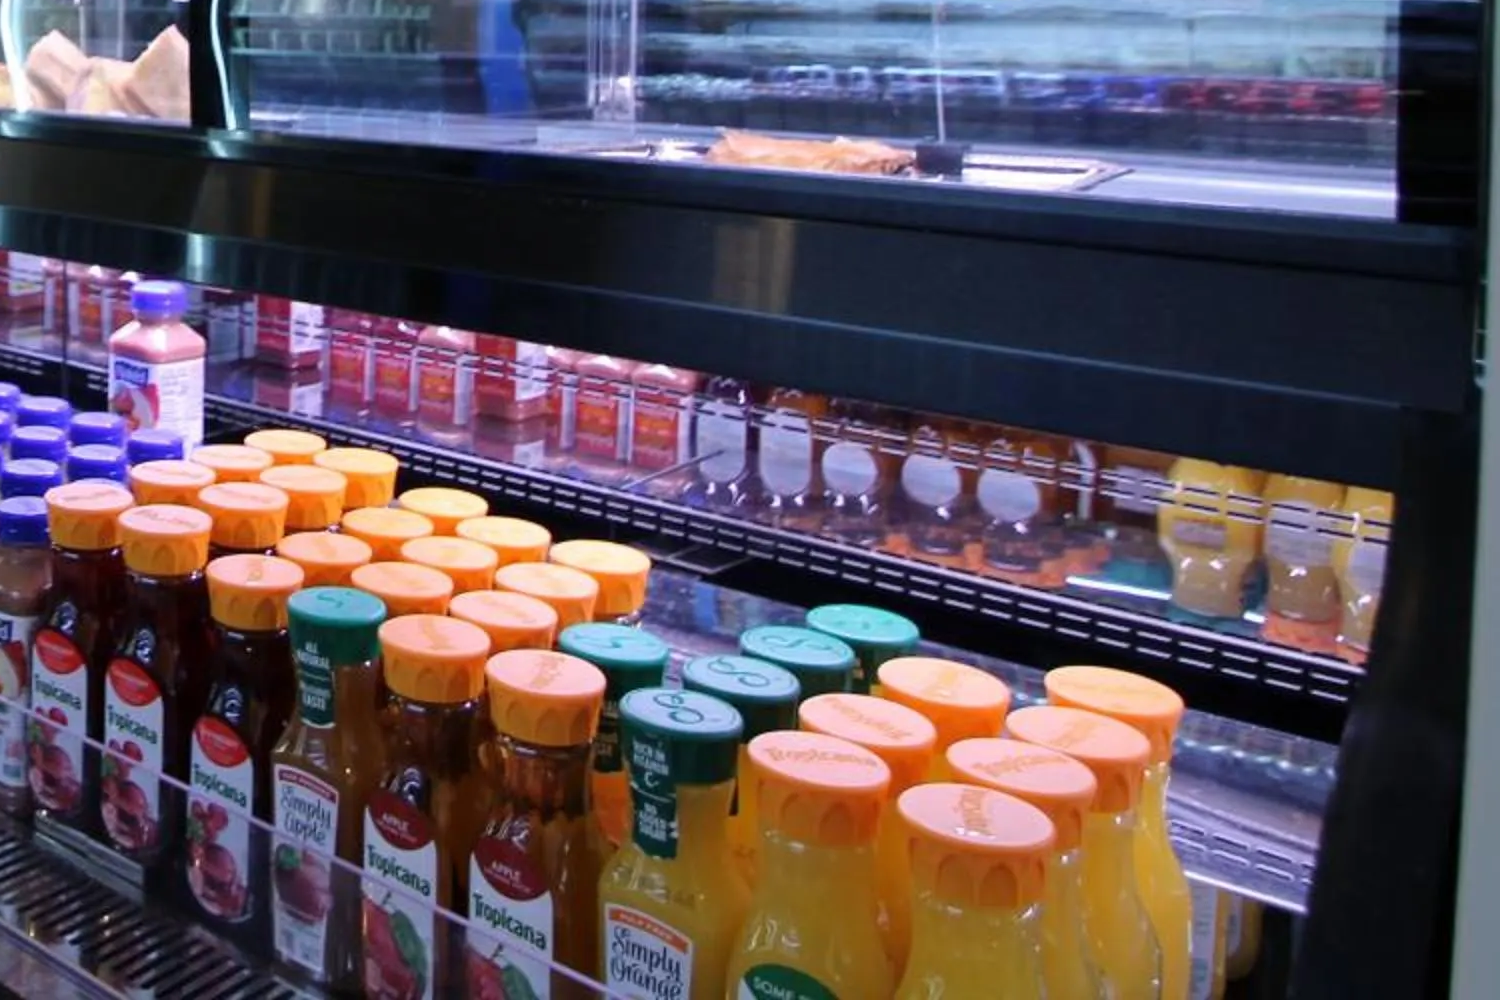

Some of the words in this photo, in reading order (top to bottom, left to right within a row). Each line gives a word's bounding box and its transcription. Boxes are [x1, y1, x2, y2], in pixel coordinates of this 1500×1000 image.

[34, 673, 82, 710] Tropicana
[108, 704, 158, 742] Tropicana
[193, 763, 247, 809] Tropicana
[644, 772, 660, 789] C
[281, 785, 332, 831] Simply
[382, 812, 410, 834] APPLE
[368, 843, 431, 897] Tropicana
[492, 860, 521, 884] APPLE
[472, 891, 547, 952] Tropicana
[611, 925, 684, 982] Simply
[610, 955, 684, 1000] Orange
